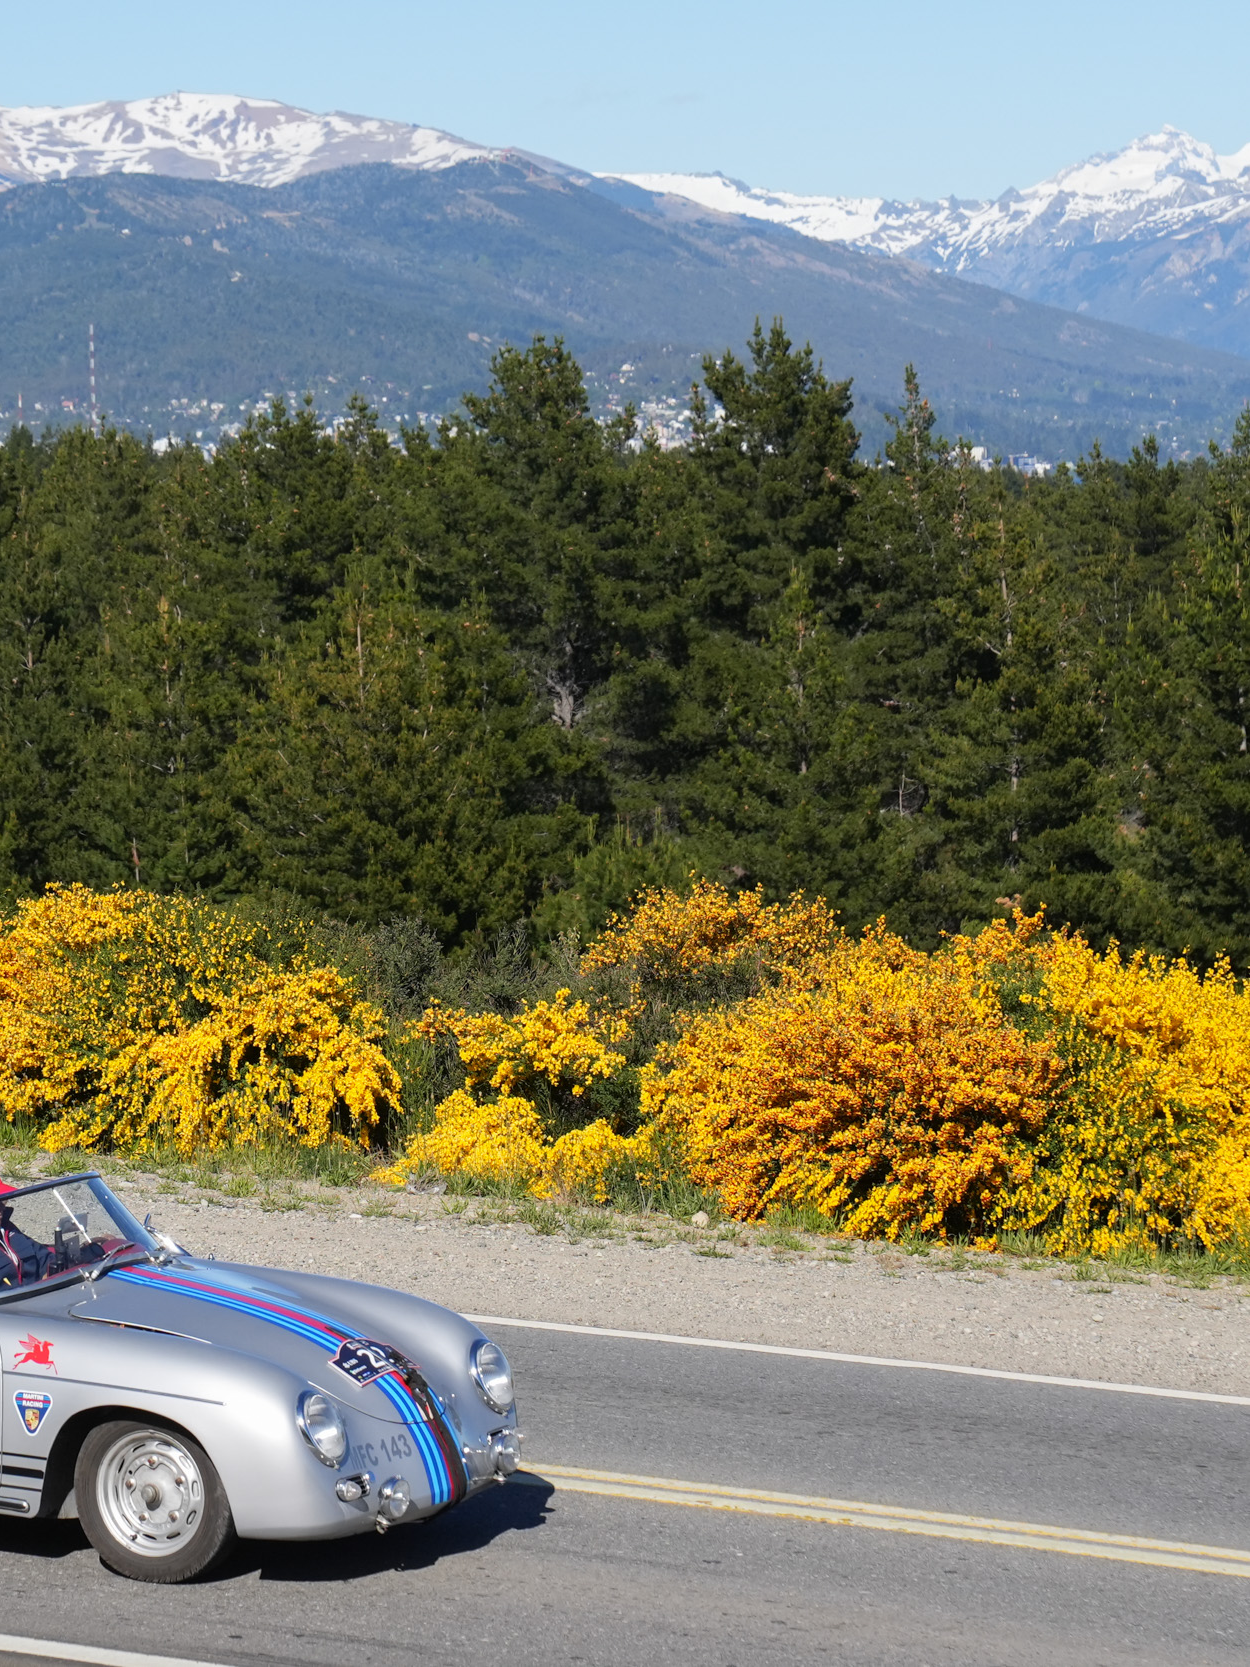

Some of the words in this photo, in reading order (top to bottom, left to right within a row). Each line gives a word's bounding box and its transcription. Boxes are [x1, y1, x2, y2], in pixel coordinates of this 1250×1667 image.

[22, 1393, 44, 1401] MARTINI
[22, 1400, 44, 1409] RACING
[381, 1434, 412, 1462] 143
